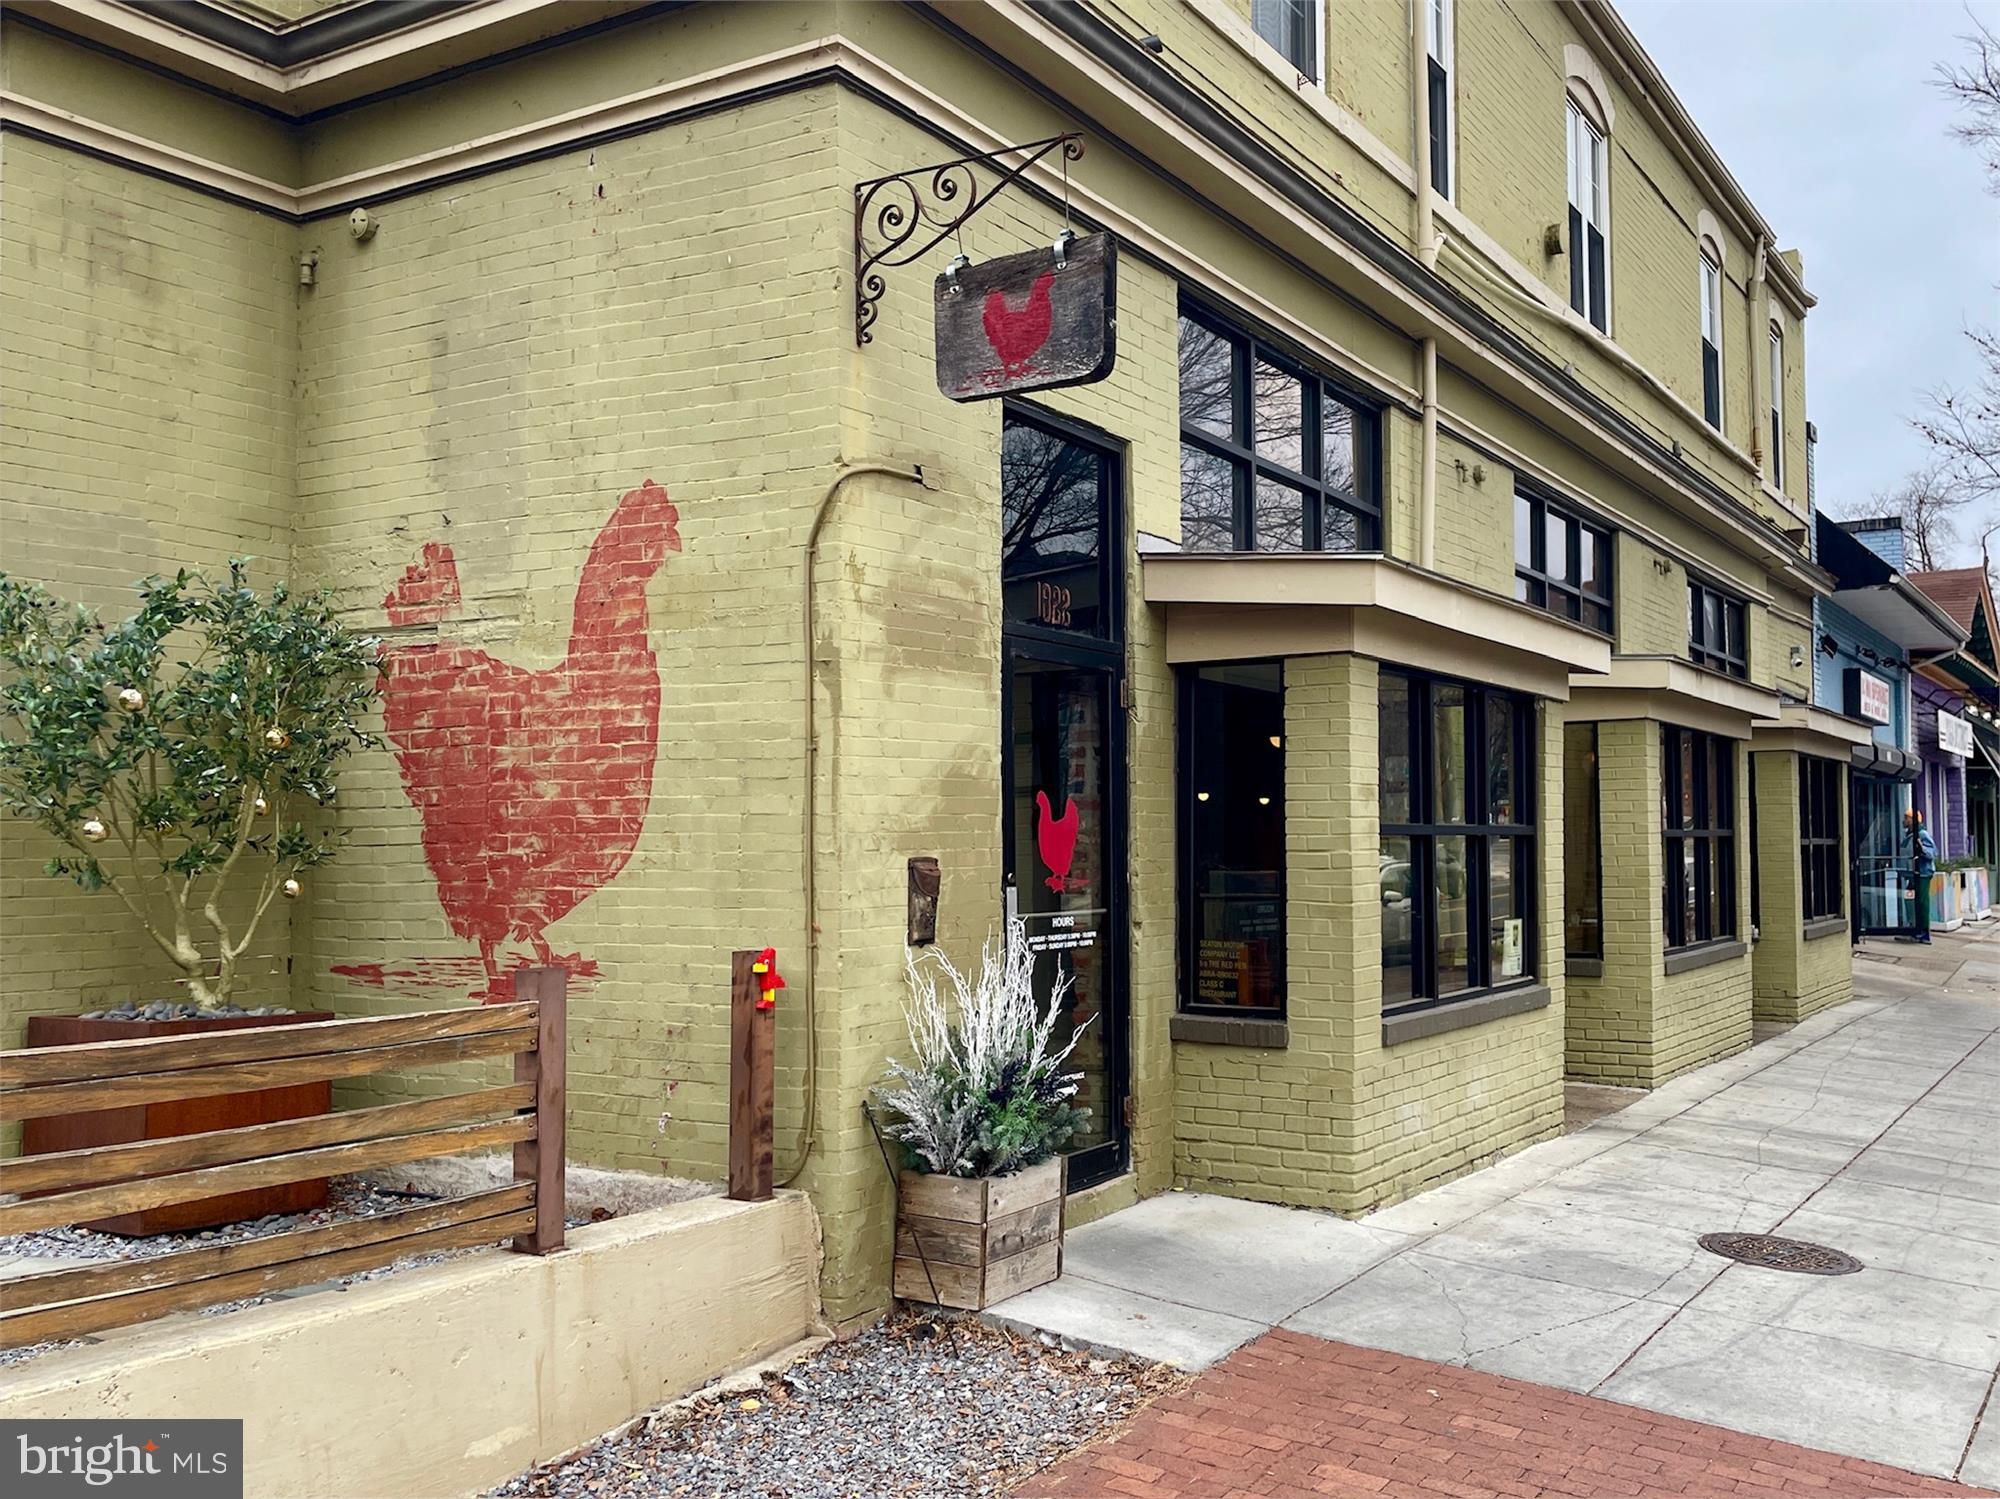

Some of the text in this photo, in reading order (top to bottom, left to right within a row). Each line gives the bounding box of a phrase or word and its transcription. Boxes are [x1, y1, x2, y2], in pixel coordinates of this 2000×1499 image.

[1052, 916, 1074, 928] HOURS
[1200, 949, 1240, 959] COMPANY LLC
[1209, 959, 1220, 968] THE
[1221, 960, 1233, 969] RED
[1199, 979, 1218, 988] CLASS
